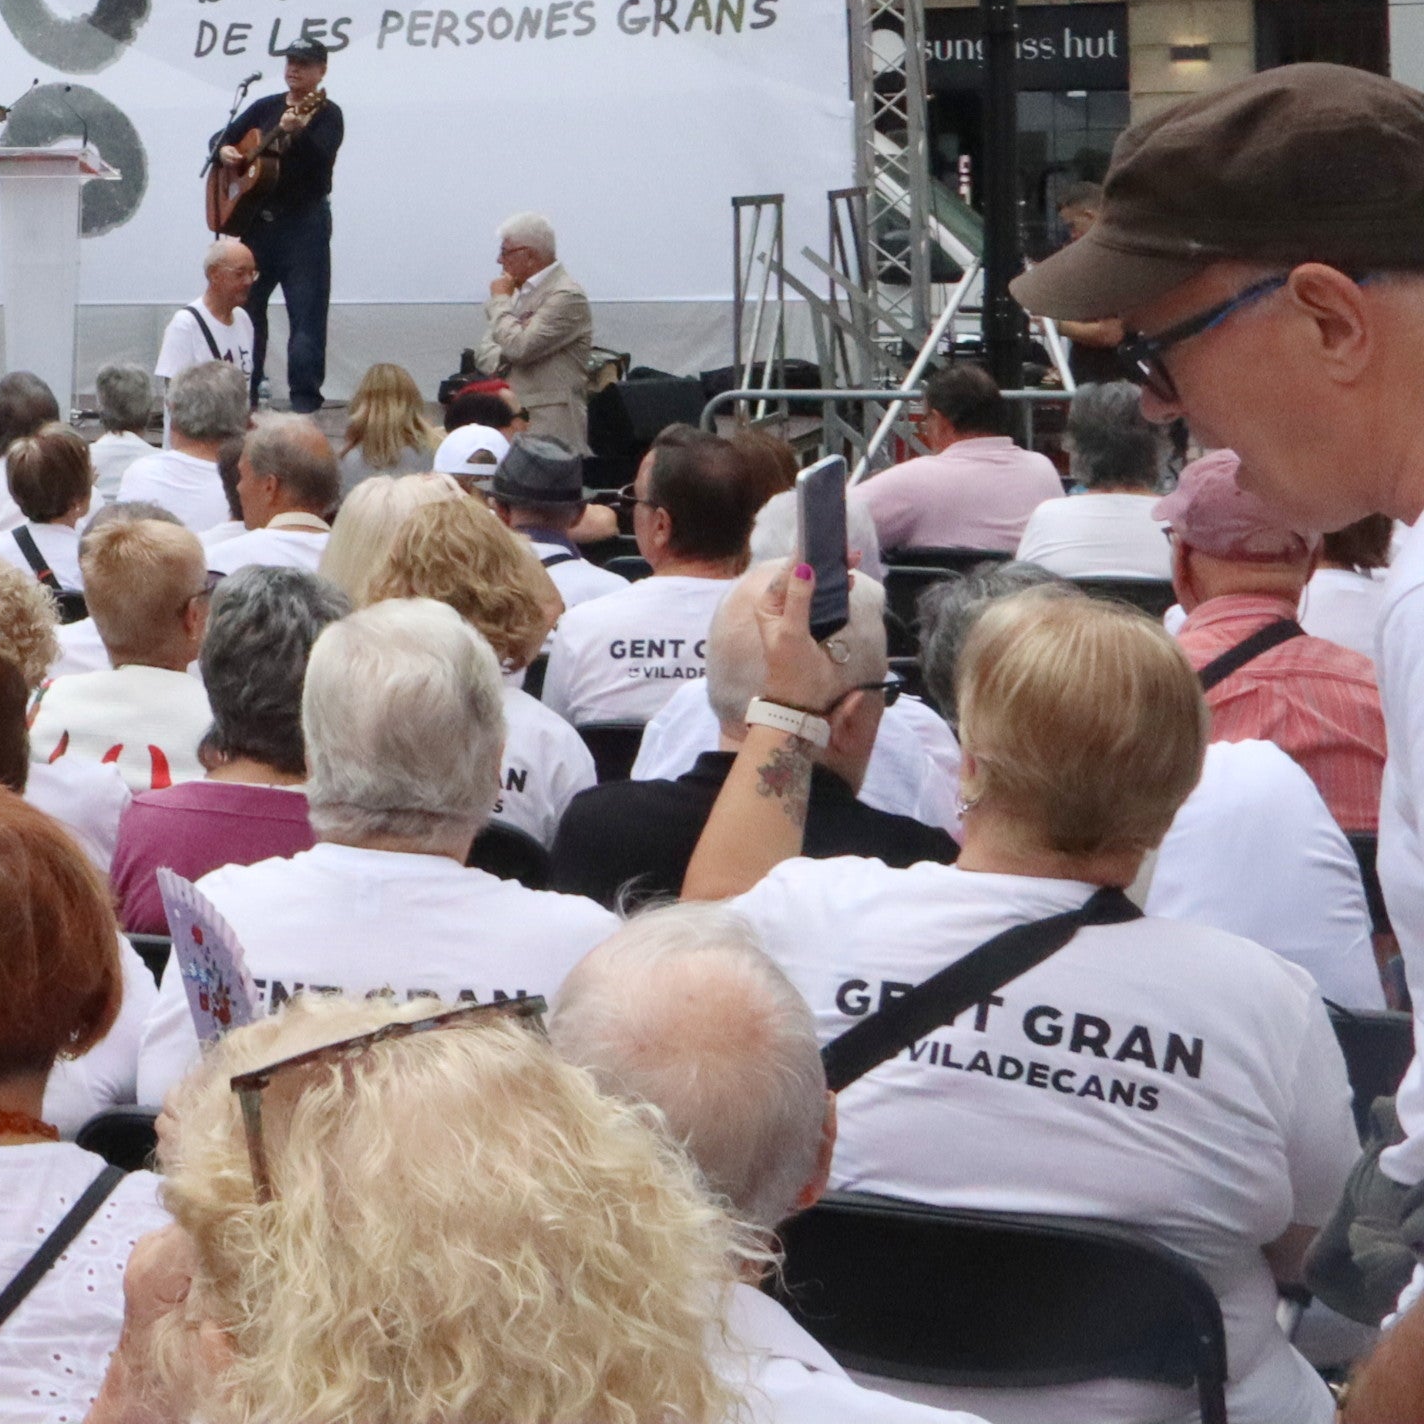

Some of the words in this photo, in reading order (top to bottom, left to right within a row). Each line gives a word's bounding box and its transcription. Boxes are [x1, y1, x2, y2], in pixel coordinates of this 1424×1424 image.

[194, 19, 253, 57] DE
[268, 17, 352, 57] LES
[377, 0, 596, 50] PERSONES
[1064, 27, 1118, 59] hut
[609, 639, 686, 659] GENT
[1022, 1004, 1204, 1079] GRAN
[906, 1039, 1160, 1112] VILADECANS
